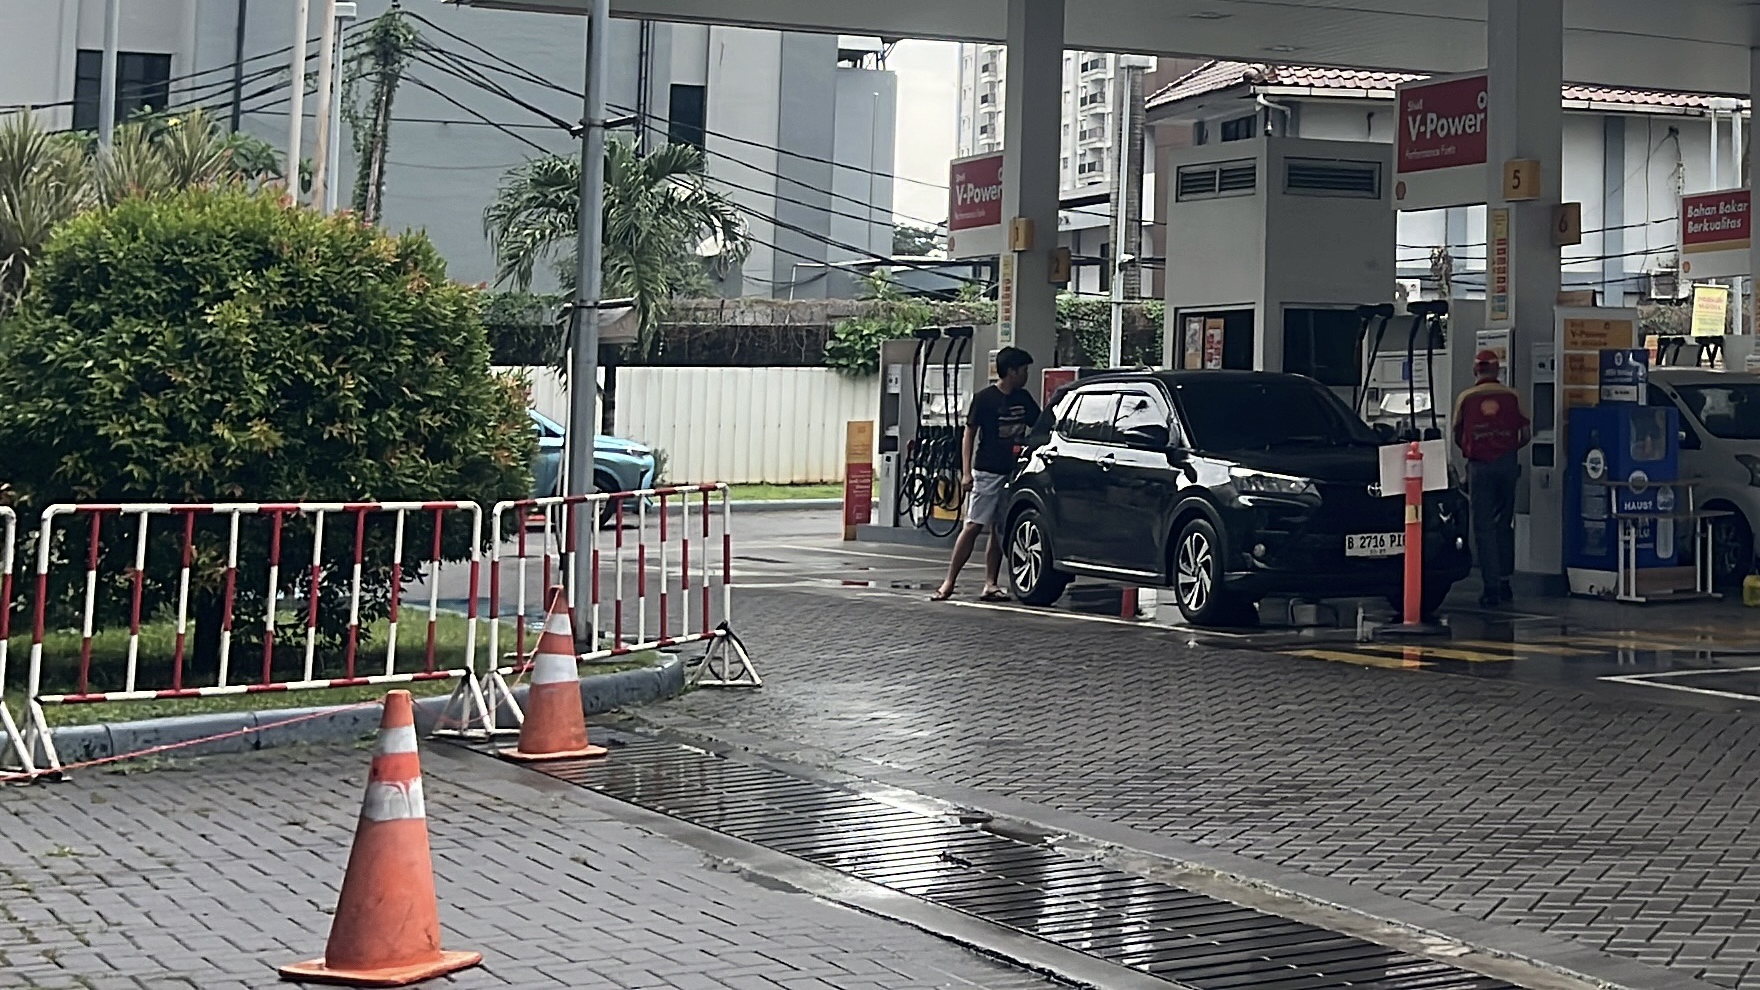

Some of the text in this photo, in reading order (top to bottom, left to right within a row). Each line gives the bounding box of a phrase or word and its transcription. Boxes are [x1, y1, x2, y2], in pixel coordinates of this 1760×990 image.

[1408, 112, 1485, 142] V-Power
[1511, 169, 1521, 190] 5
[1687, 200, 1748, 218] Bahan Bakar
[1558, 213, 1568, 233] 6
[1687, 217, 1742, 234] Berkualitas
[1347, 534, 1405, 549] B 2716 PI
